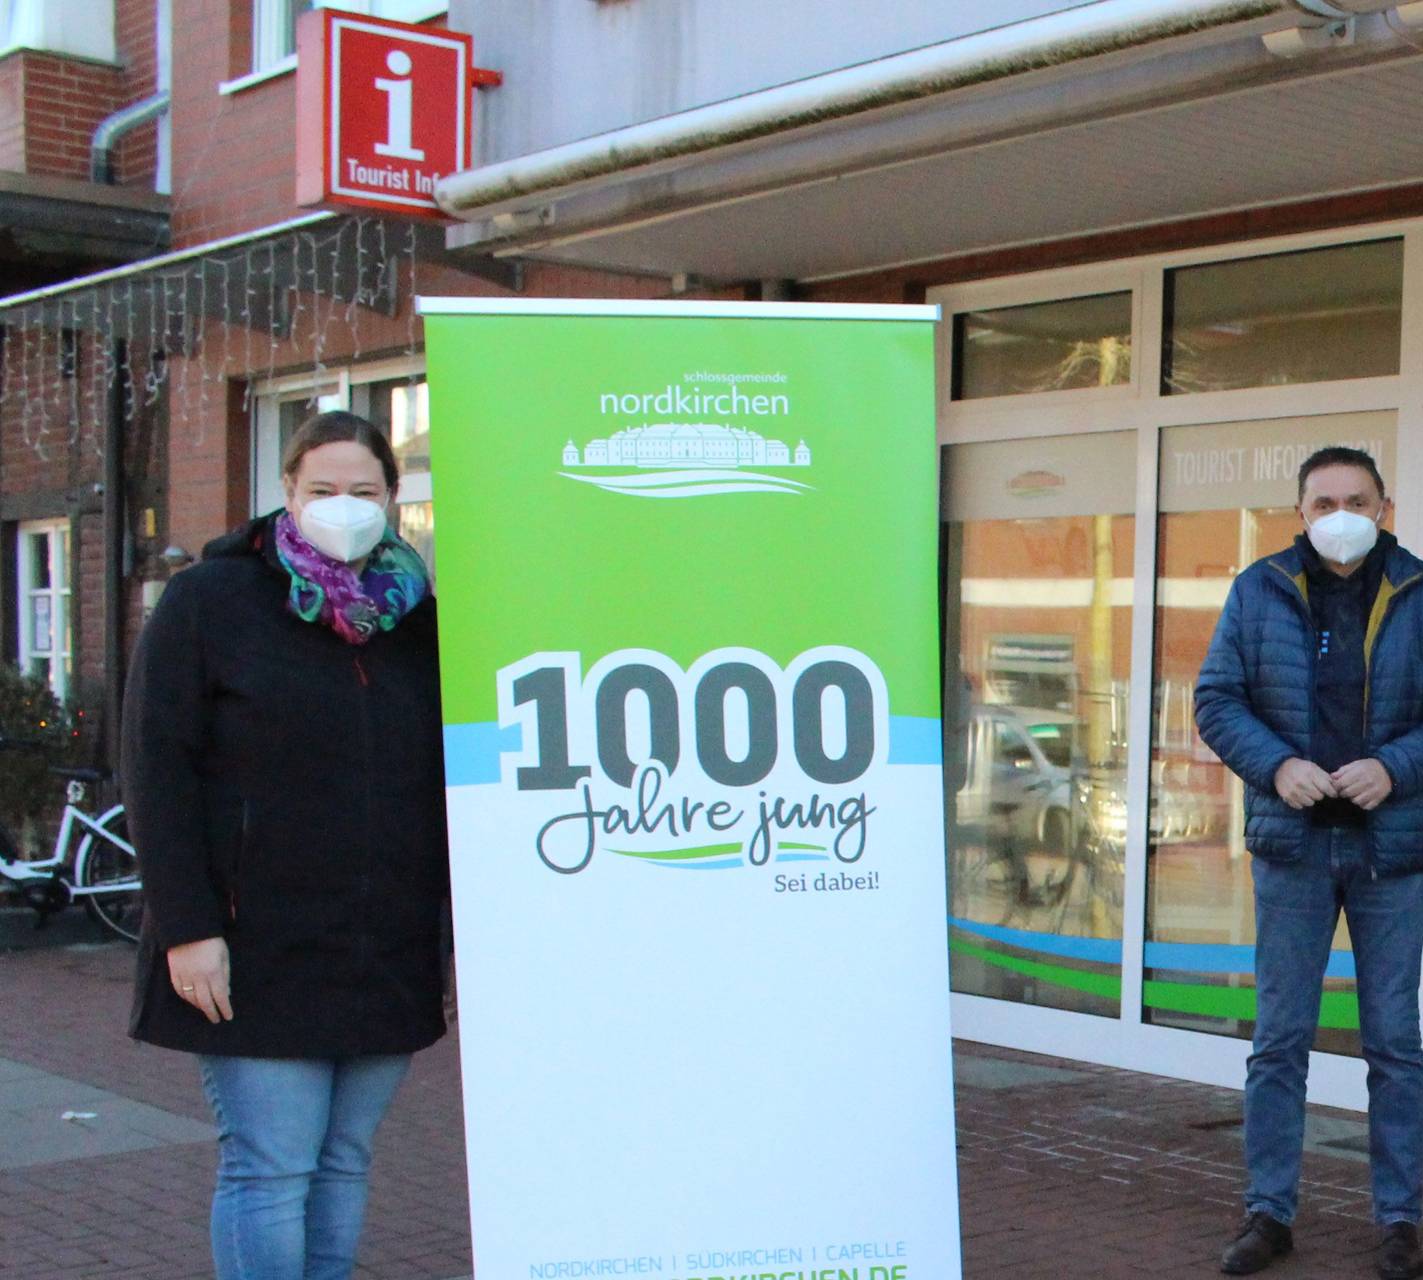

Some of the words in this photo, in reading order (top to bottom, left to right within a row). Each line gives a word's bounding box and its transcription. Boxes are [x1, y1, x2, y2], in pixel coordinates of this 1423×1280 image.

[347, 158, 409, 191] Tourist
[415, 169, 441, 194] Inf
[683, 371, 787, 385] schlossgemeinde
[600, 384, 789, 416] nordkirchen
[1174, 447, 1246, 486] TOURIST
[512, 659, 875, 791] 1000
[536, 766, 744, 875] Jahre
[748, 790, 877, 866] jung
[774, 873, 807, 893] Sei
[813, 871, 880, 891] dabei!
[529, 1255, 662, 1279] NORDKIRCHEN
[826, 1241, 907, 1261] CAPELLE
